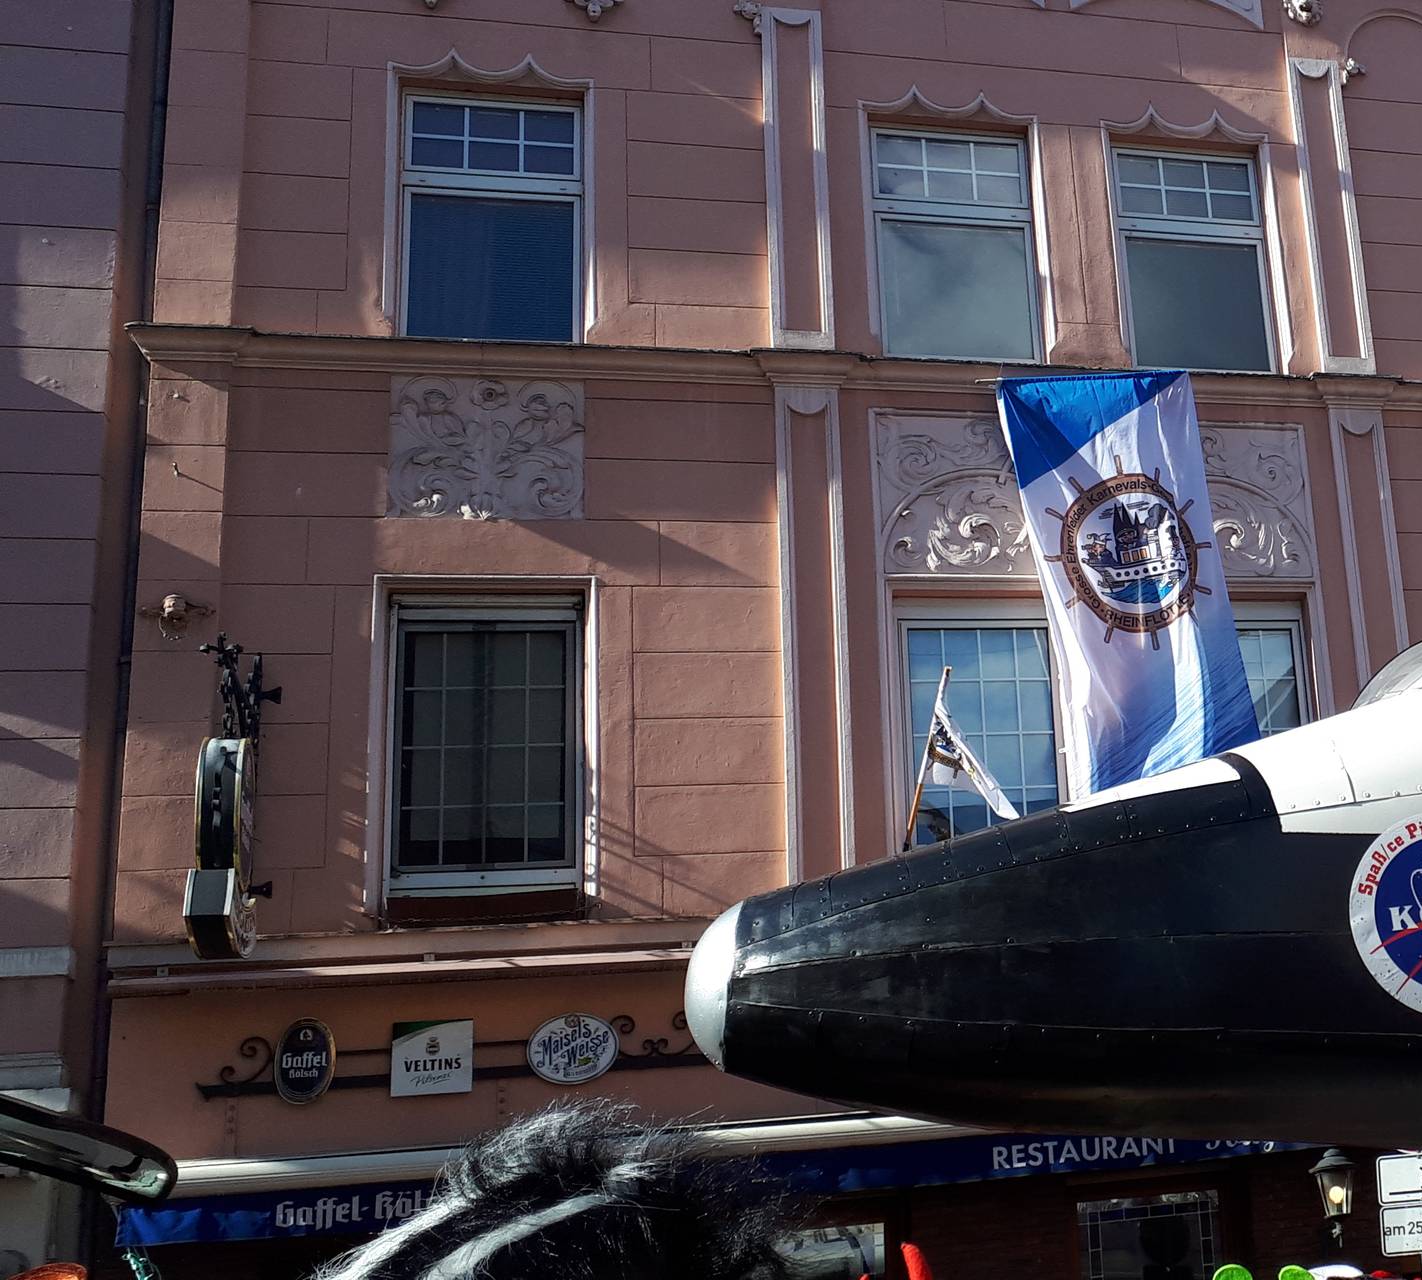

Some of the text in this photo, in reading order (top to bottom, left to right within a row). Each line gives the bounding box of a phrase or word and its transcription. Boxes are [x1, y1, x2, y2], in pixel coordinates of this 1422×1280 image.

[1067, 503, 1088, 564] Ehrenfelder
[1072, 566, 1101, 609] Grosse
[536, 1019, 592, 1069] Maisel's
[560, 1030, 609, 1067] Weisse
[282, 1051, 328, 1069] Gaffel
[288, 1068, 319, 1079] Kölsch
[403, 1057, 462, 1073] VELTINS
[1384, 1225, 1406, 1237] am
